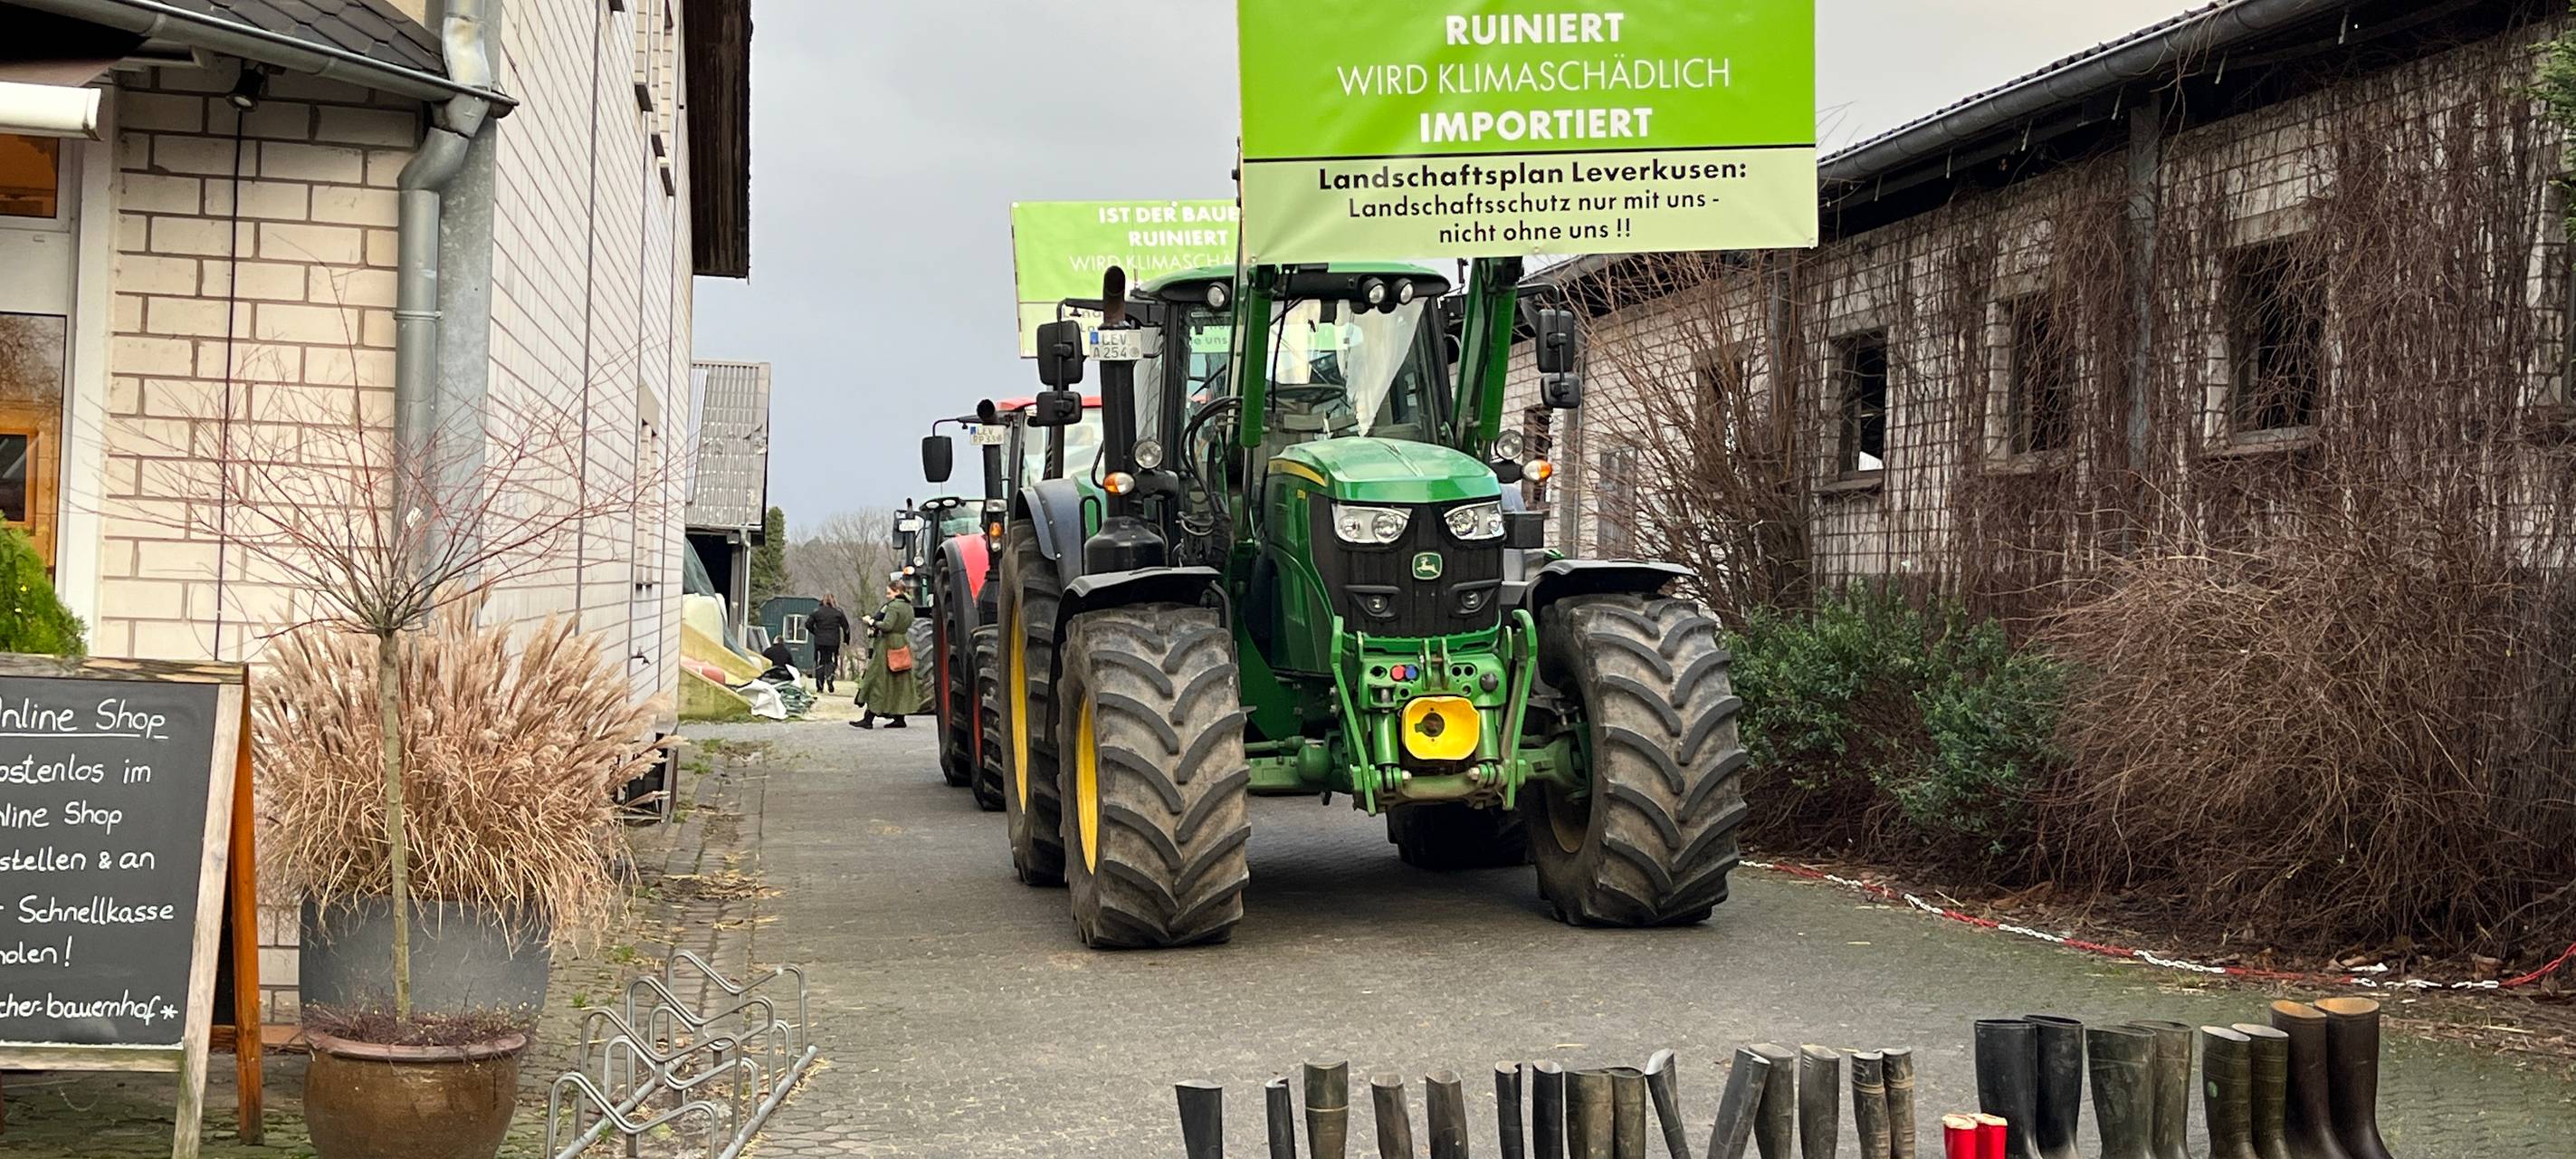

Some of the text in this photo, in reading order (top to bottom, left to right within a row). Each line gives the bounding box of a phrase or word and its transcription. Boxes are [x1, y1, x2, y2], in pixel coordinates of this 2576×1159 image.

[1445, 12, 1625, 45] RUINIERT
[1337, 53, 1730, 96] WIRD KLIMASCHÄDLICH
[1419, 108, 1653, 143] IMPORTIERT
[1319, 158, 1747, 191] Landschaftsplan Leverkusen:
[1099, 205, 1239, 224] IST DER BAUE
[1350, 192, 1570, 217] Landschaftsschutz
[1579, 196, 1617, 211] nur
[1624, 189, 1659, 209] mit
[1667, 193, 1706, 208] uns
[1129, 229, 1228, 247] RUINIERT
[1440, 220, 1496, 243] nicht
[1503, 218, 1562, 241] ohne
[1569, 224, 1608, 239] uns
[1069, 250, 1238, 272] WIRD KLIMASCHÄ
[1092, 347, 1127, 359] A 254
[1102, 332, 1127, 346] LEV
[1205, 336, 1228, 345] uns
[0, 696, 166, 739] nline Shop
[0, 753, 151, 784] ostenlos im
[64, 800, 122, 835] Shop
[0, 846, 155, 872] stellen & an
[18, 895, 174, 924] Schnellkasse
